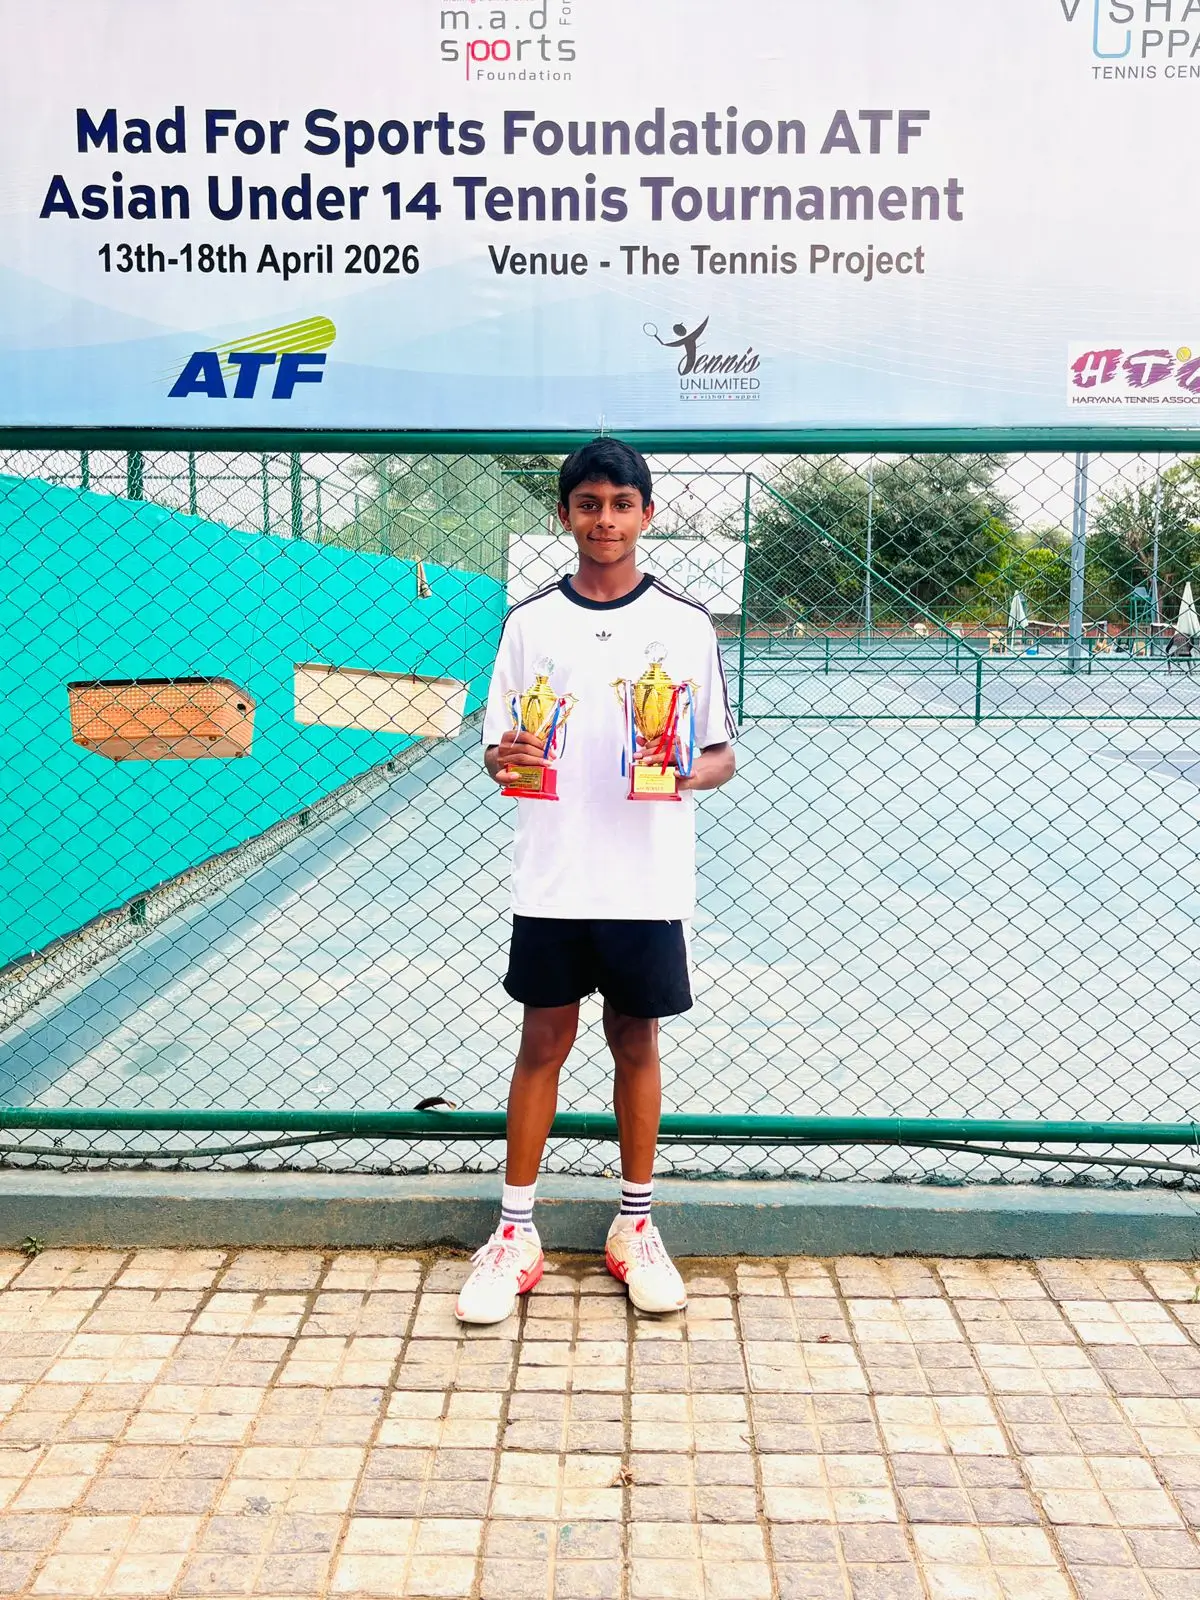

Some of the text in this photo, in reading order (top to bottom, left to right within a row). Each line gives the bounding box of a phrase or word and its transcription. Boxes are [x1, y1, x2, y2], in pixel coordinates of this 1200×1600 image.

[441, 0, 546, 29] m.a.d
[441, 34, 576, 81] sports
[477, 69, 572, 81] Foundation
[1092, 66, 1157, 79] TENNIS
[76, 105, 930, 168] Mad For Sports Foundation ATF
[39, 171, 964, 222] Asian Under 14 Tennis Tournament
[98, 243, 420, 281] 13th-18th April 2026
[488, 244, 588, 276] Venue
[619, 245, 680, 275] The
[691, 244, 798, 275] Tennis
[809, 244, 926, 282] Project
[168, 351, 328, 399] ATF
[680, 377, 761, 391] UNLIMITED
[1072, 396, 1123, 404] HARYANA
[1124, 396, 1160, 404] TENNIS
